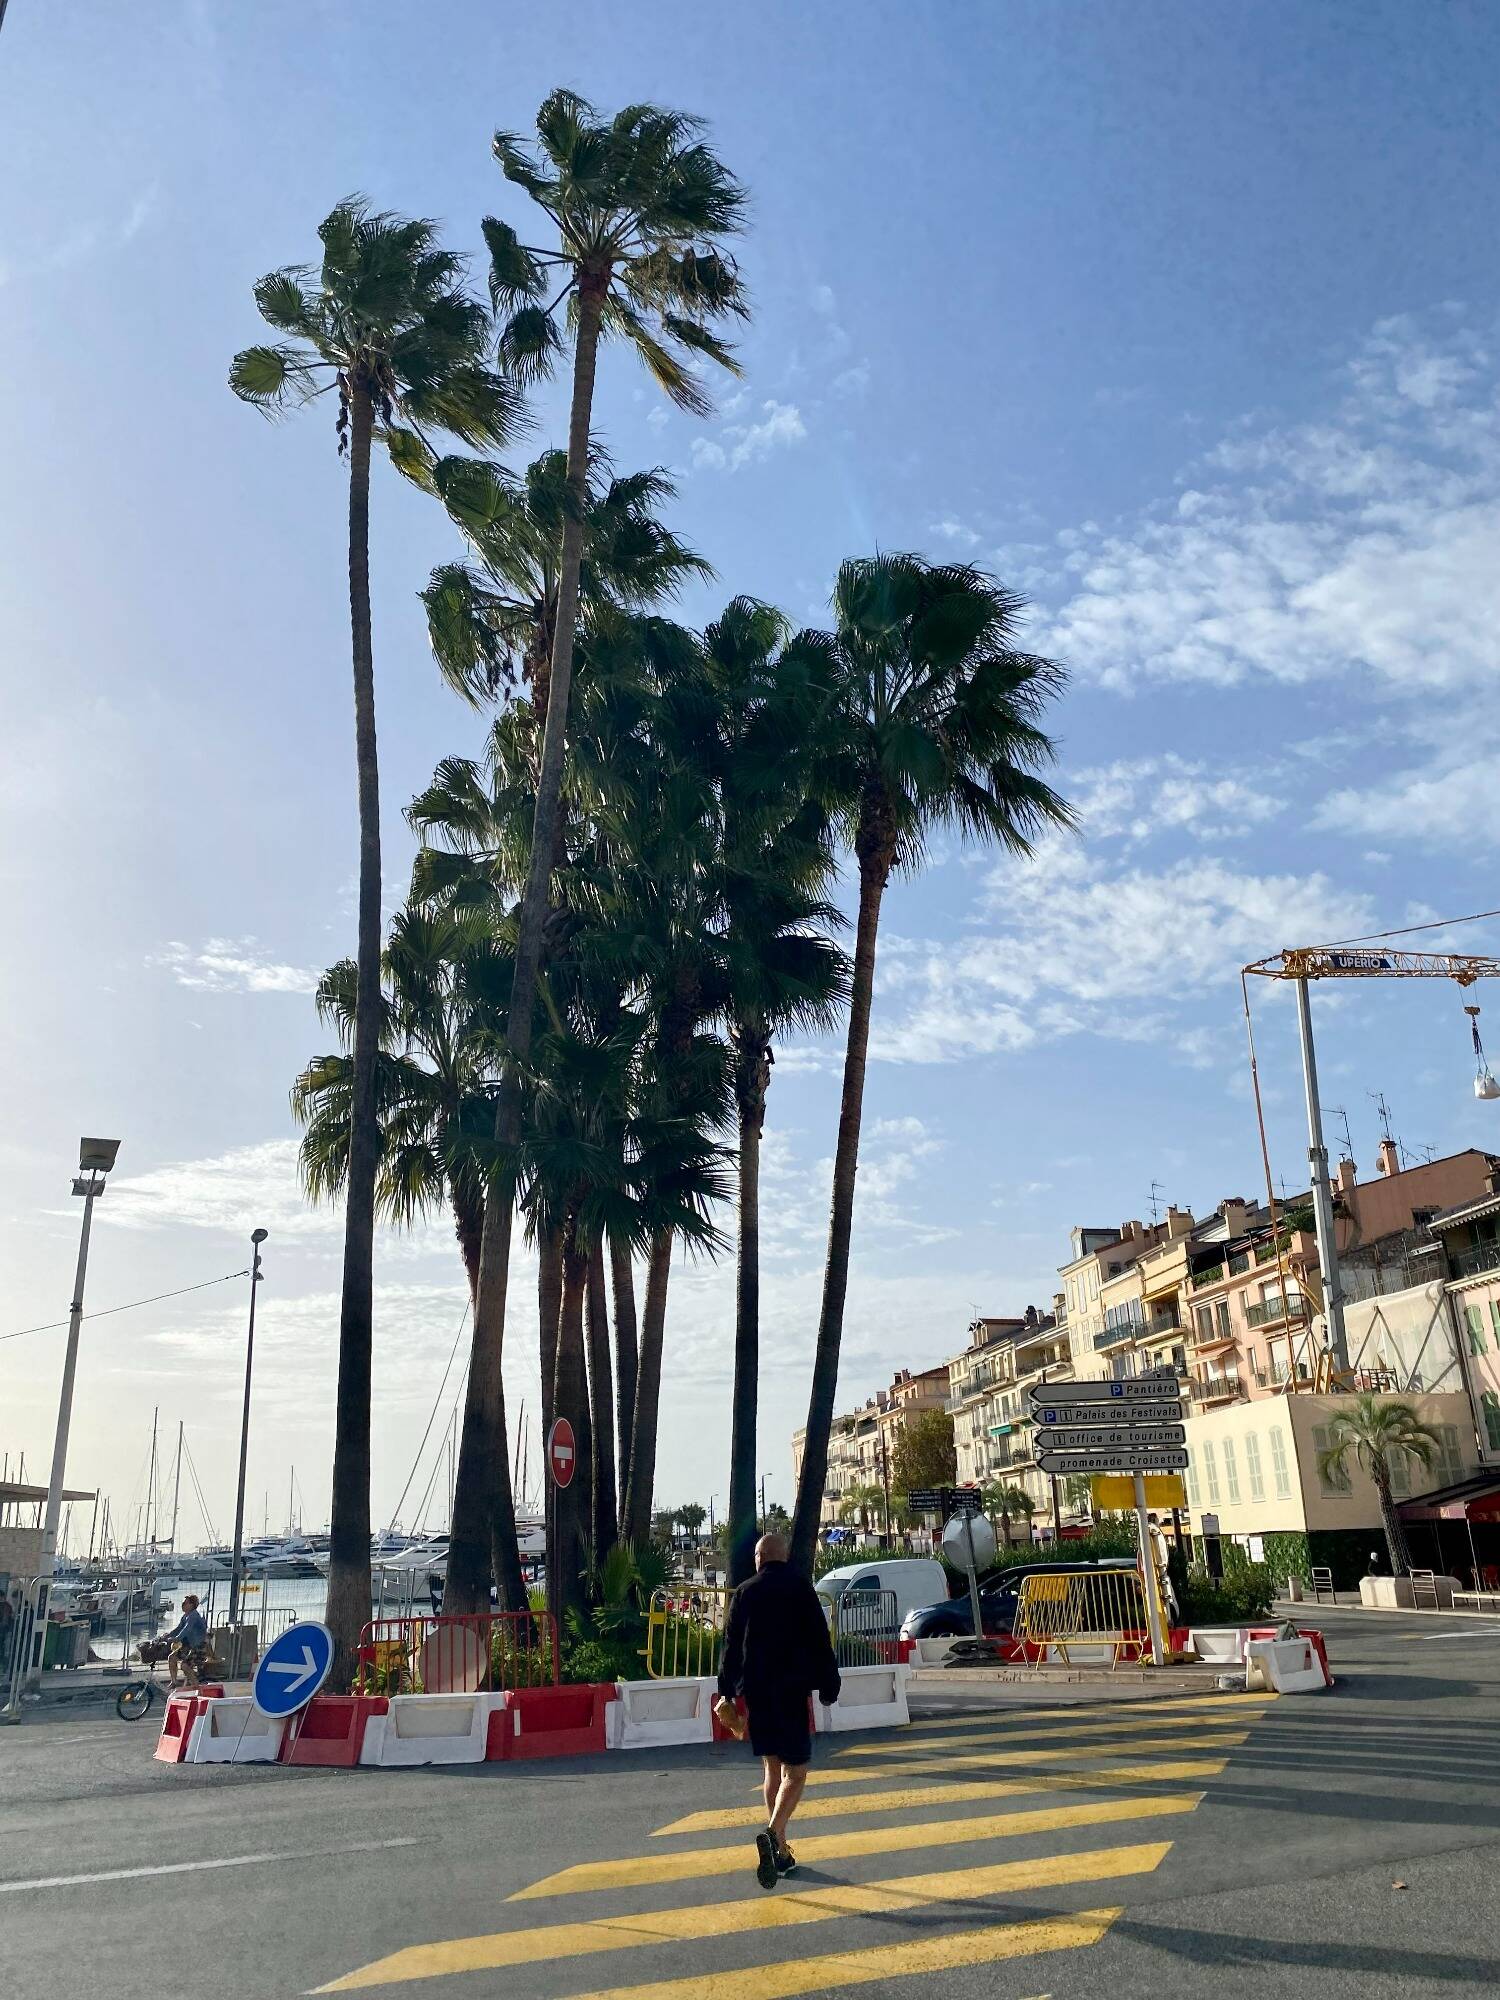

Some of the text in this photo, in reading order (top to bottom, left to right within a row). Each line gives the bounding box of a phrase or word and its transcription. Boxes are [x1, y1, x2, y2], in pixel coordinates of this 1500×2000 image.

[1339, 956, 1380, 969] UPERIO
[1112, 1385, 1121, 1396] P
[1046, 1411, 1054, 1422] P
[1076, 1409, 1106, 1420] Palais
[1110, 1409, 1127, 1419] des
[1131, 1407, 1177, 1418] Festivals
[1069, 1433, 1103, 1444] office
[1109, 1432, 1122, 1442] de
[1129, 1430, 1180, 1441] tourisme
[1060, 1455, 1183, 1470] promenade Croisette
